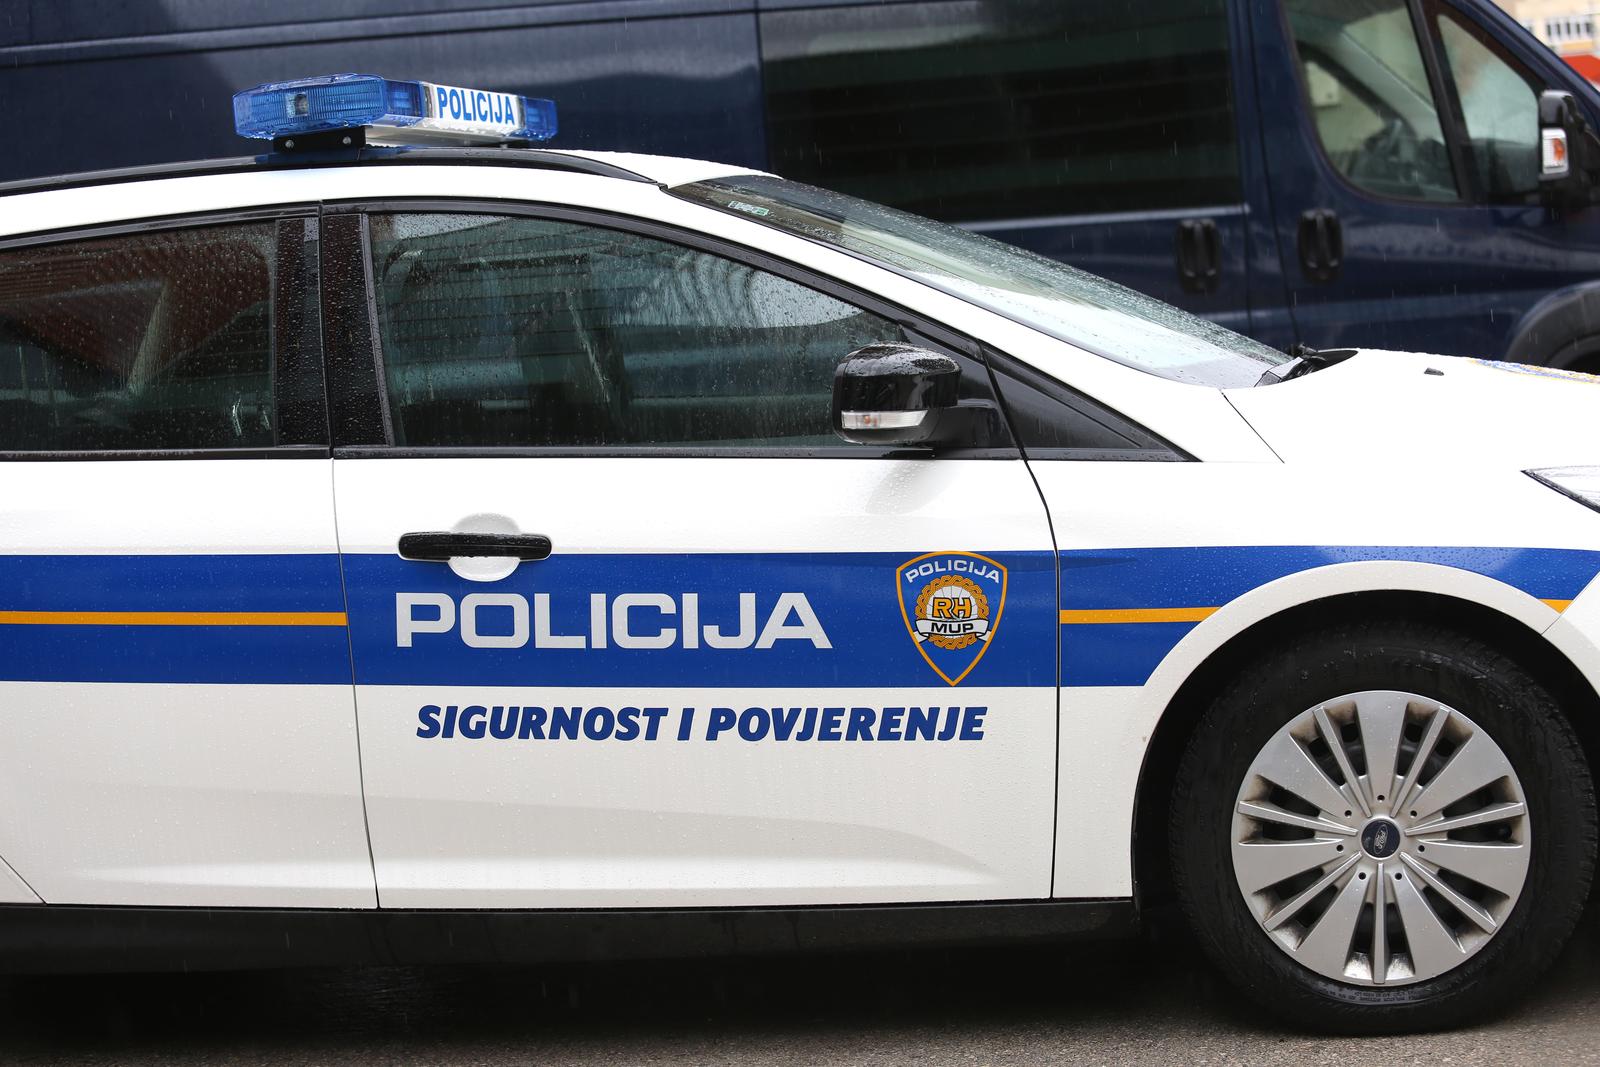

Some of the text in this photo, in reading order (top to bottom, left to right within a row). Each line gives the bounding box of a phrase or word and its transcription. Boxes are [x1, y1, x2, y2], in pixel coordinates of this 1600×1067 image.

[436, 86, 515, 126] POLICIJA
[905, 559, 1000, 584] POLICIJA
[395, 592, 833, 650] POLICIJA
[932, 597, 973, 619] RH
[930, 622, 974, 634] MUP
[416, 704, 988, 742] SIGURNOST I POVJERENJE
